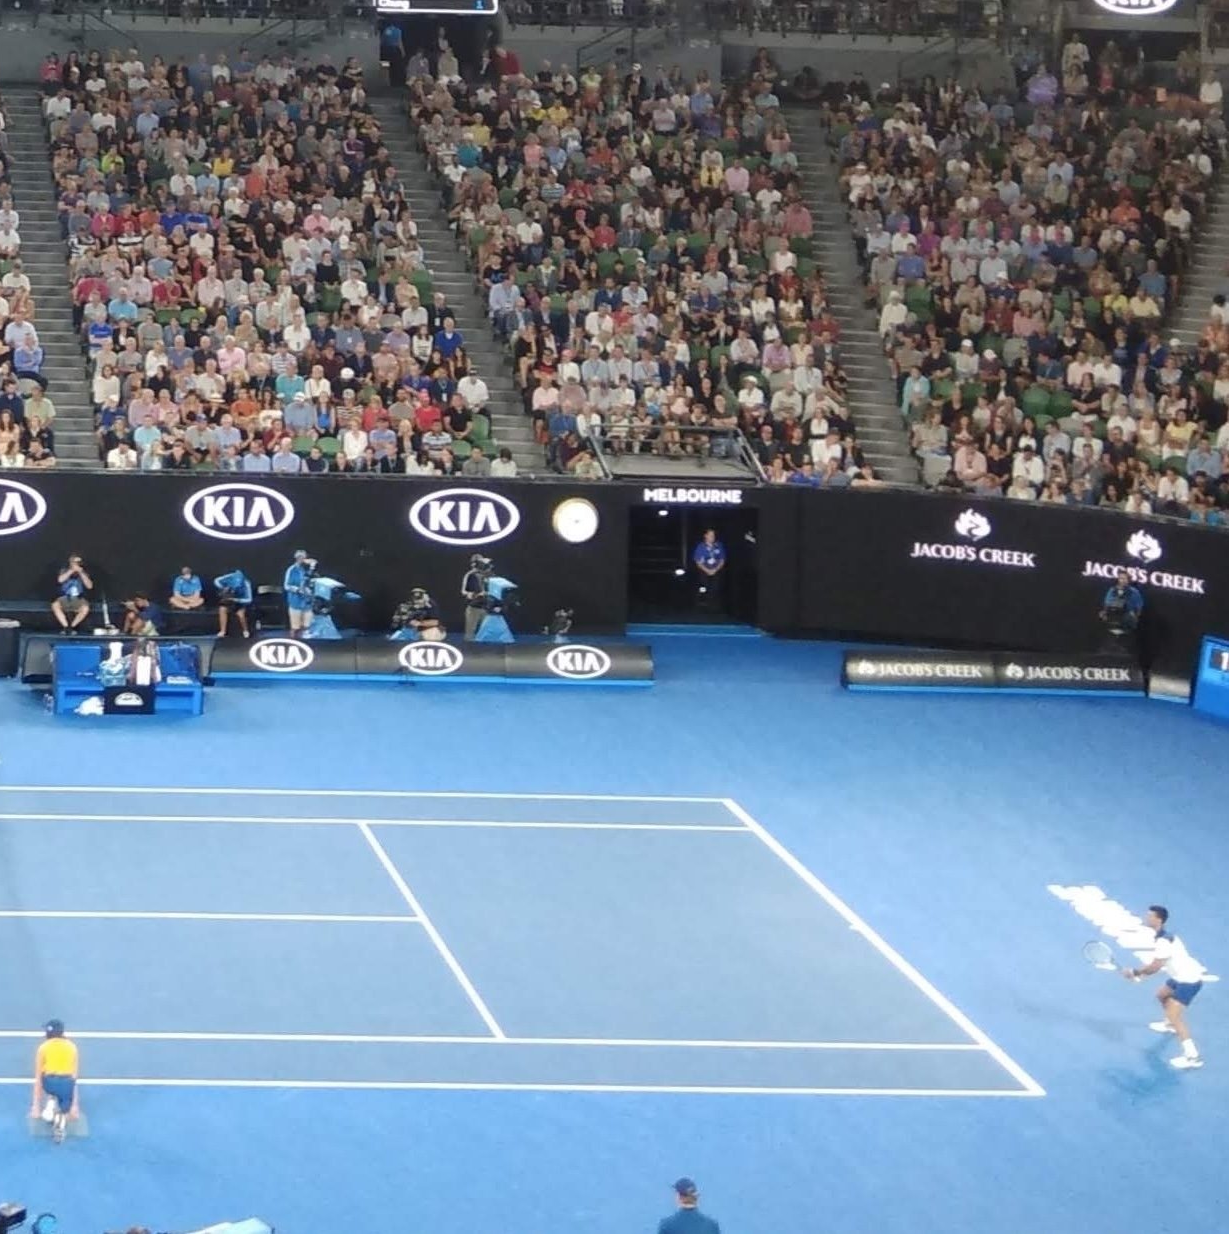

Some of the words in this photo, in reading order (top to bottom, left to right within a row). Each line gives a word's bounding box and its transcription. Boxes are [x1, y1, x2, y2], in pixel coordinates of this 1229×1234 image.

[475, 0, 485, 9] 1
[643, 487, 743, 504] MELBOURNE
[202, 495, 276, 527] KIA
[428, 500, 502, 533] KIA
[910, 542, 977, 562] JACOB'S
[978, 547, 1037, 568] CREEK
[1150, 570, 1206, 594] CREEK
[260, 644, 303, 665] KIA
[410, 646, 453, 668] KIA
[558, 650, 601, 671] KIA
[878, 662, 934, 678] JACOB'S
[934, 665, 982, 679] CREEK
[1026, 666, 1082, 680] JACOB'S
[1083, 667, 1132, 681] CREEK
